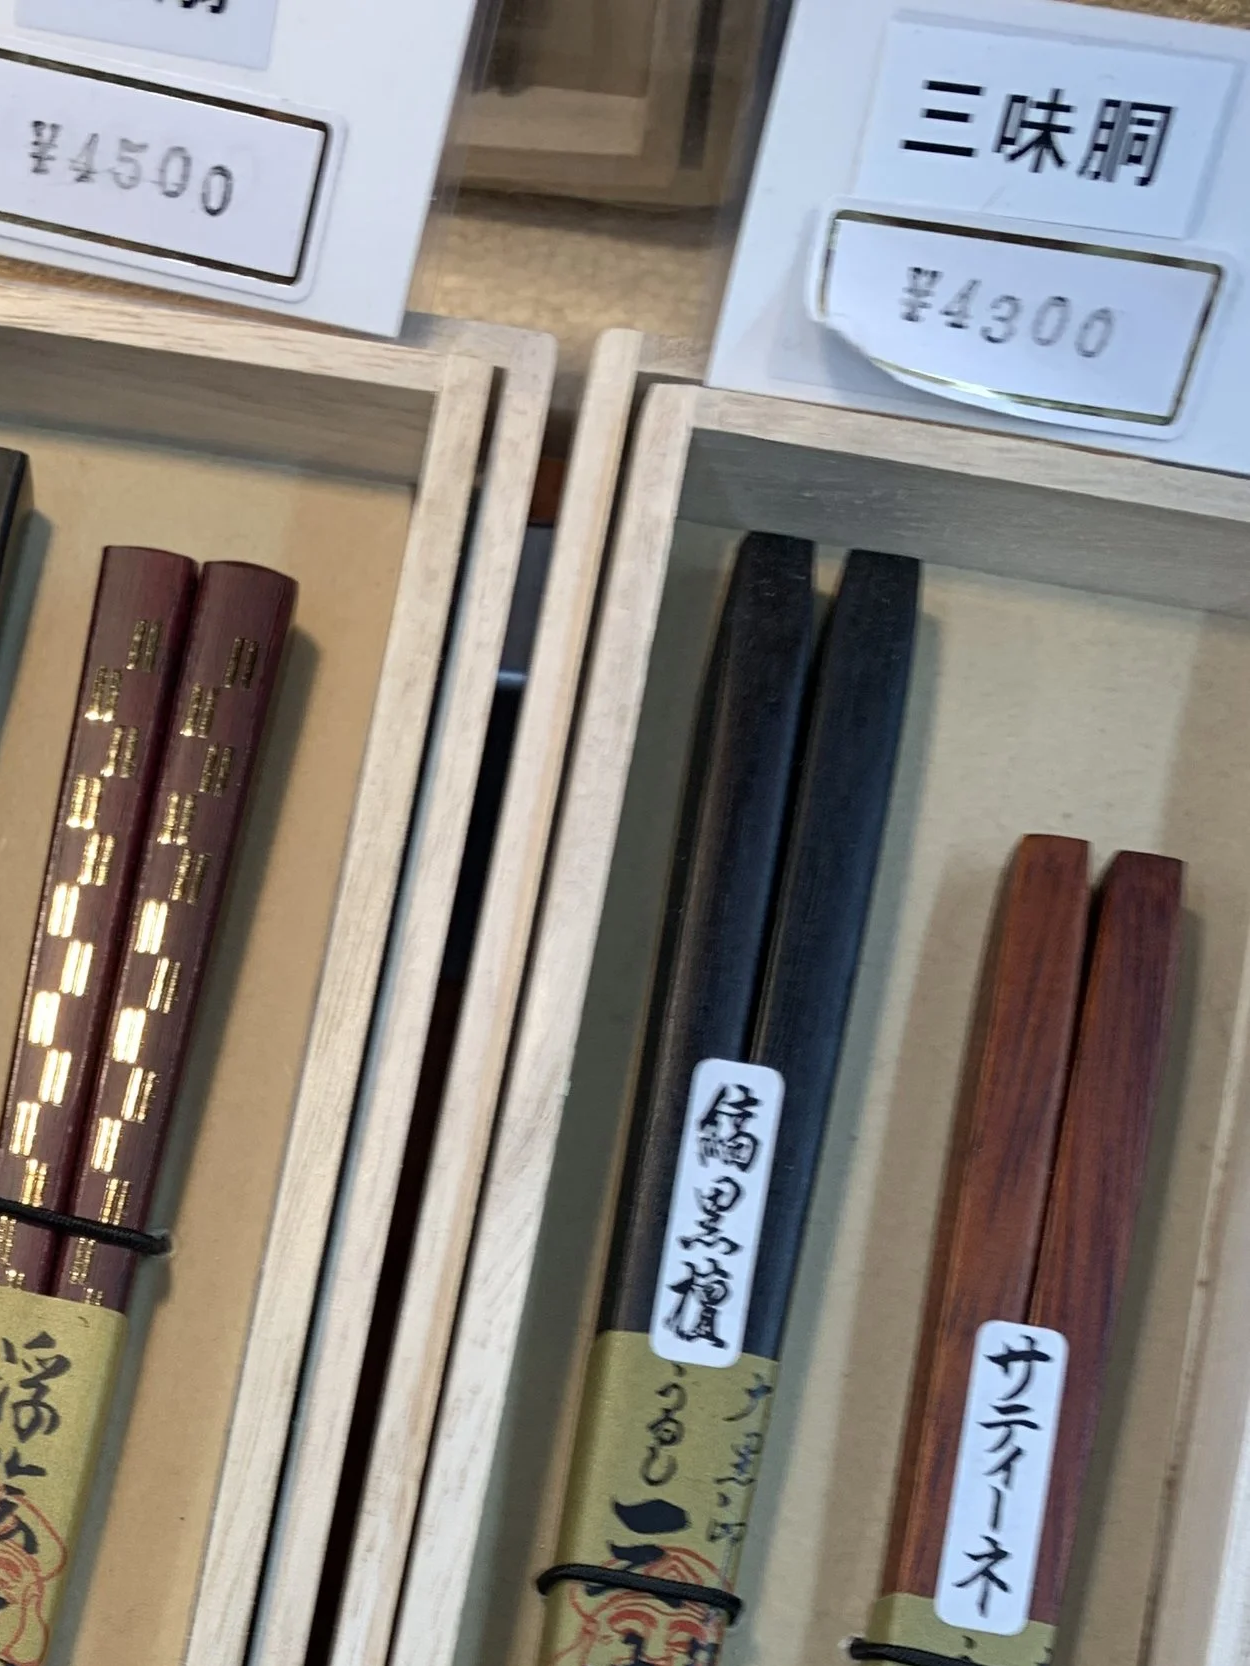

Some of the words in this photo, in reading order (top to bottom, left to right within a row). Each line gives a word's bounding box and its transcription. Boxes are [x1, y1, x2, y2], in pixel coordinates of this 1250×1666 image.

[26, 119, 236, 218] ¥4500
[900, 79, 1177, 188] 三味胴
[900, 266, 1118, 360] ¥4300
[951, 1333, 1055, 1619] サティーネ
